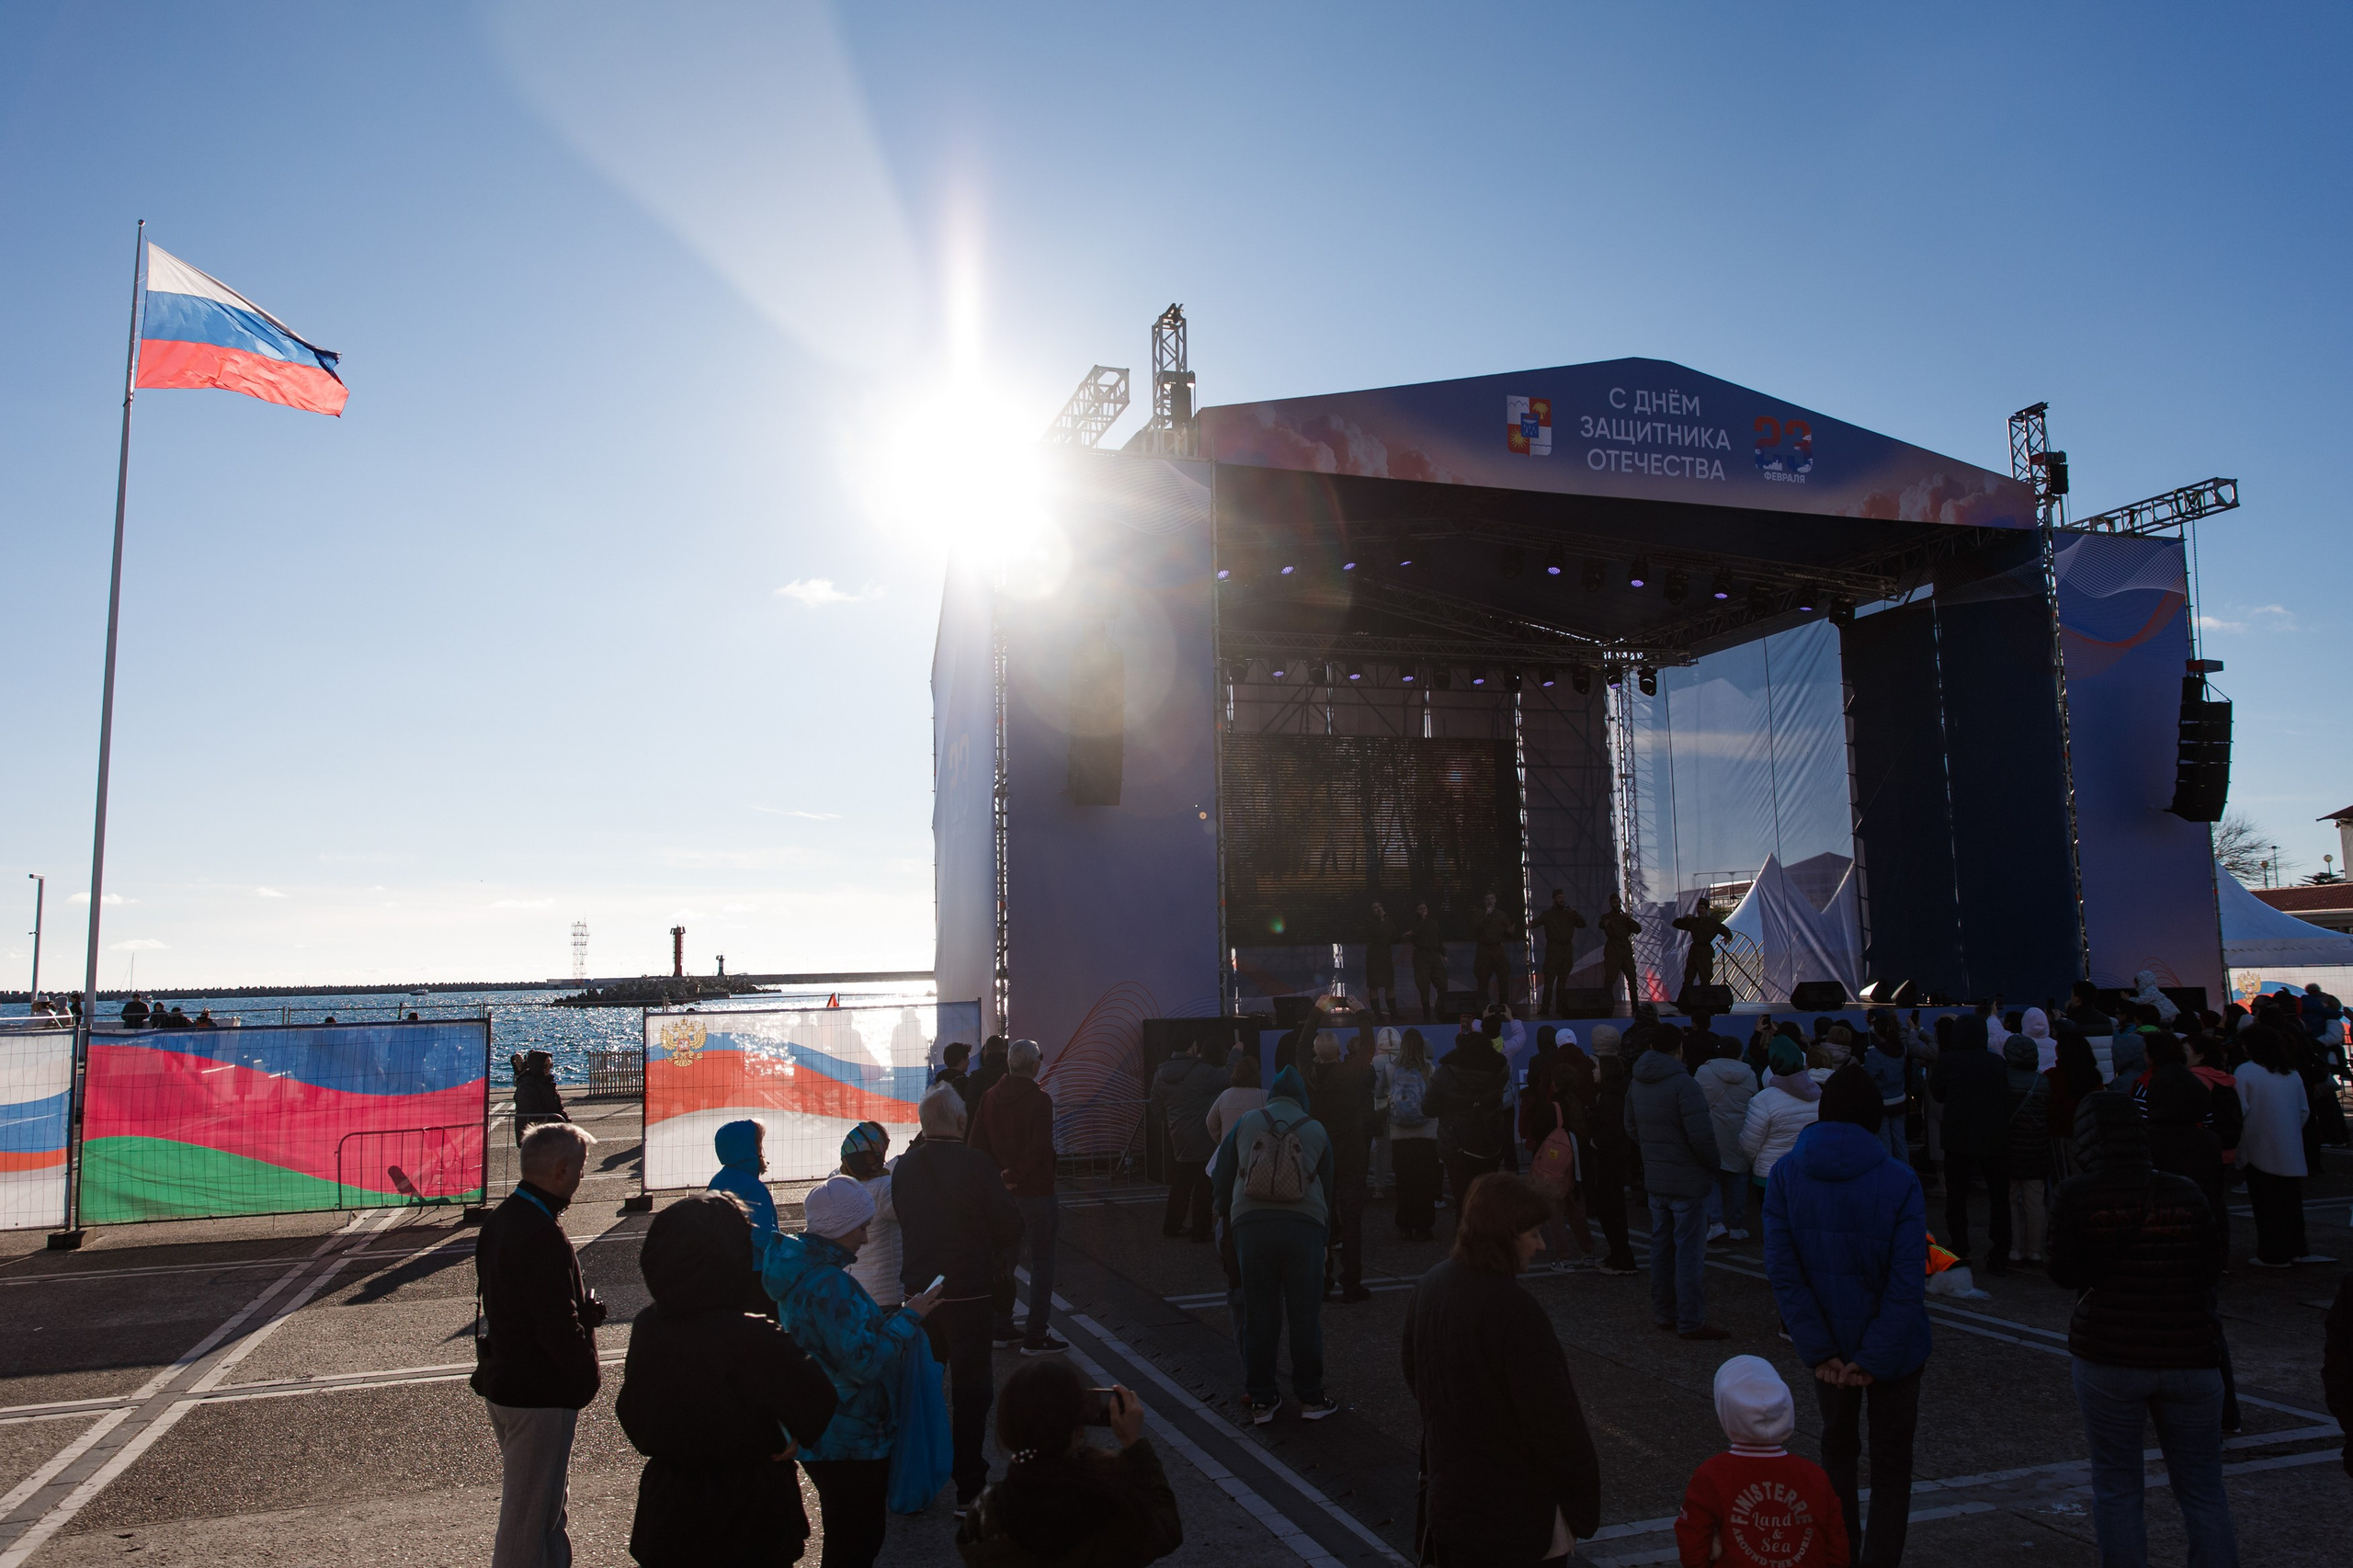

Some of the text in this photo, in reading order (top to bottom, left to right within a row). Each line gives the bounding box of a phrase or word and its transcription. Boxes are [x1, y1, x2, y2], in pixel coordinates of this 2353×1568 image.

[1608, 387, 1700, 416] С ДНЁМ
[1580, 415, 1731, 450] ЗАЩИТНИКА
[1753, 415, 1813, 473] 23
[1586, 449, 1726, 481] ОТЕЧЕСТВА
[1764, 471, 1805, 484] ФЕВРАЛЯ
[1730, 1481, 1813, 1525] FINISTERRE
[1752, 1511, 1791, 1531] Land
[1771, 1528, 1784, 1540] &
[1732, 1527, 1768, 1566] AROUND
[1791, 1527, 1813, 1563] WORLD
[1760, 1537, 1791, 1553] Sea
